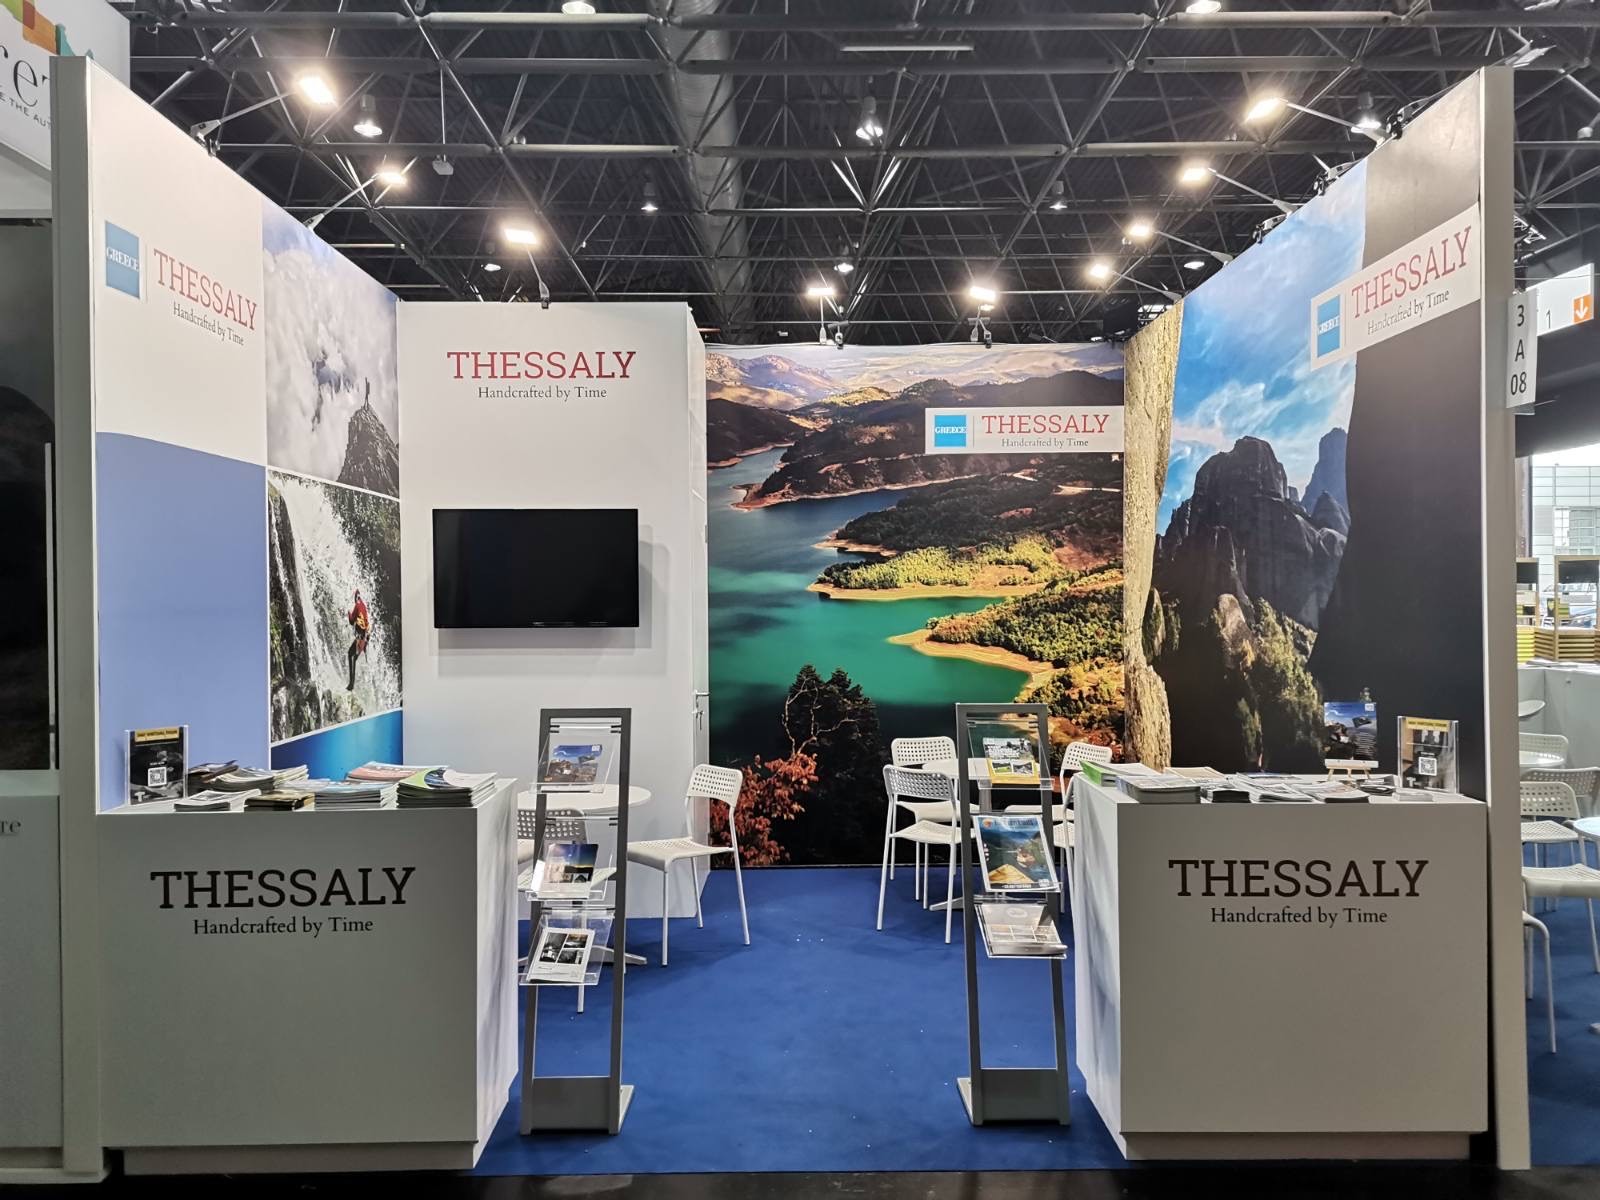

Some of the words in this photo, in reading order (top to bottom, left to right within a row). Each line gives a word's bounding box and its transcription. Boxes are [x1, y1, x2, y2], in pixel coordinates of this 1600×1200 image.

[1351, 225, 1472, 318] THESSALY
[105, 246, 140, 271] GREECE
[153, 248, 257, 331] THESSALY
[173, 301, 216, 334] Handcrafted
[217, 324, 227, 341] by
[227, 327, 245, 346] Time
[1367, 304, 1412, 335] Handcrafted
[1414, 299, 1425, 318] by
[1427, 289, 1450, 309] Time
[1517, 304, 1525, 327] 3
[1514, 339, 1525, 362] A
[447, 351, 637, 379] THESSALY
[478, 385, 552, 399] Handcrafted
[556, 386, 571, 402] by
[574, 386, 607, 399] Time
[1510, 371, 1527, 396] 08
[934, 426, 967, 435] GREECE
[981, 414, 1110, 434] THESSALY
[1001, 437, 1051, 448] Handcrafted
[1055, 437, 1063, 449] by
[1067, 437, 1089, 448] Time
[150, 866, 416, 909] THESSALY
[1168, 859, 1430, 898] THESSALY
[193, 916, 297, 935] Handcrafted
[302, 916, 323, 938] by
[328, 916, 374, 932] Time
[1211, 905, 1313, 924] Handcrafted
[1318, 905, 1338, 929] by
[1343, 906, 1388, 924] Time
